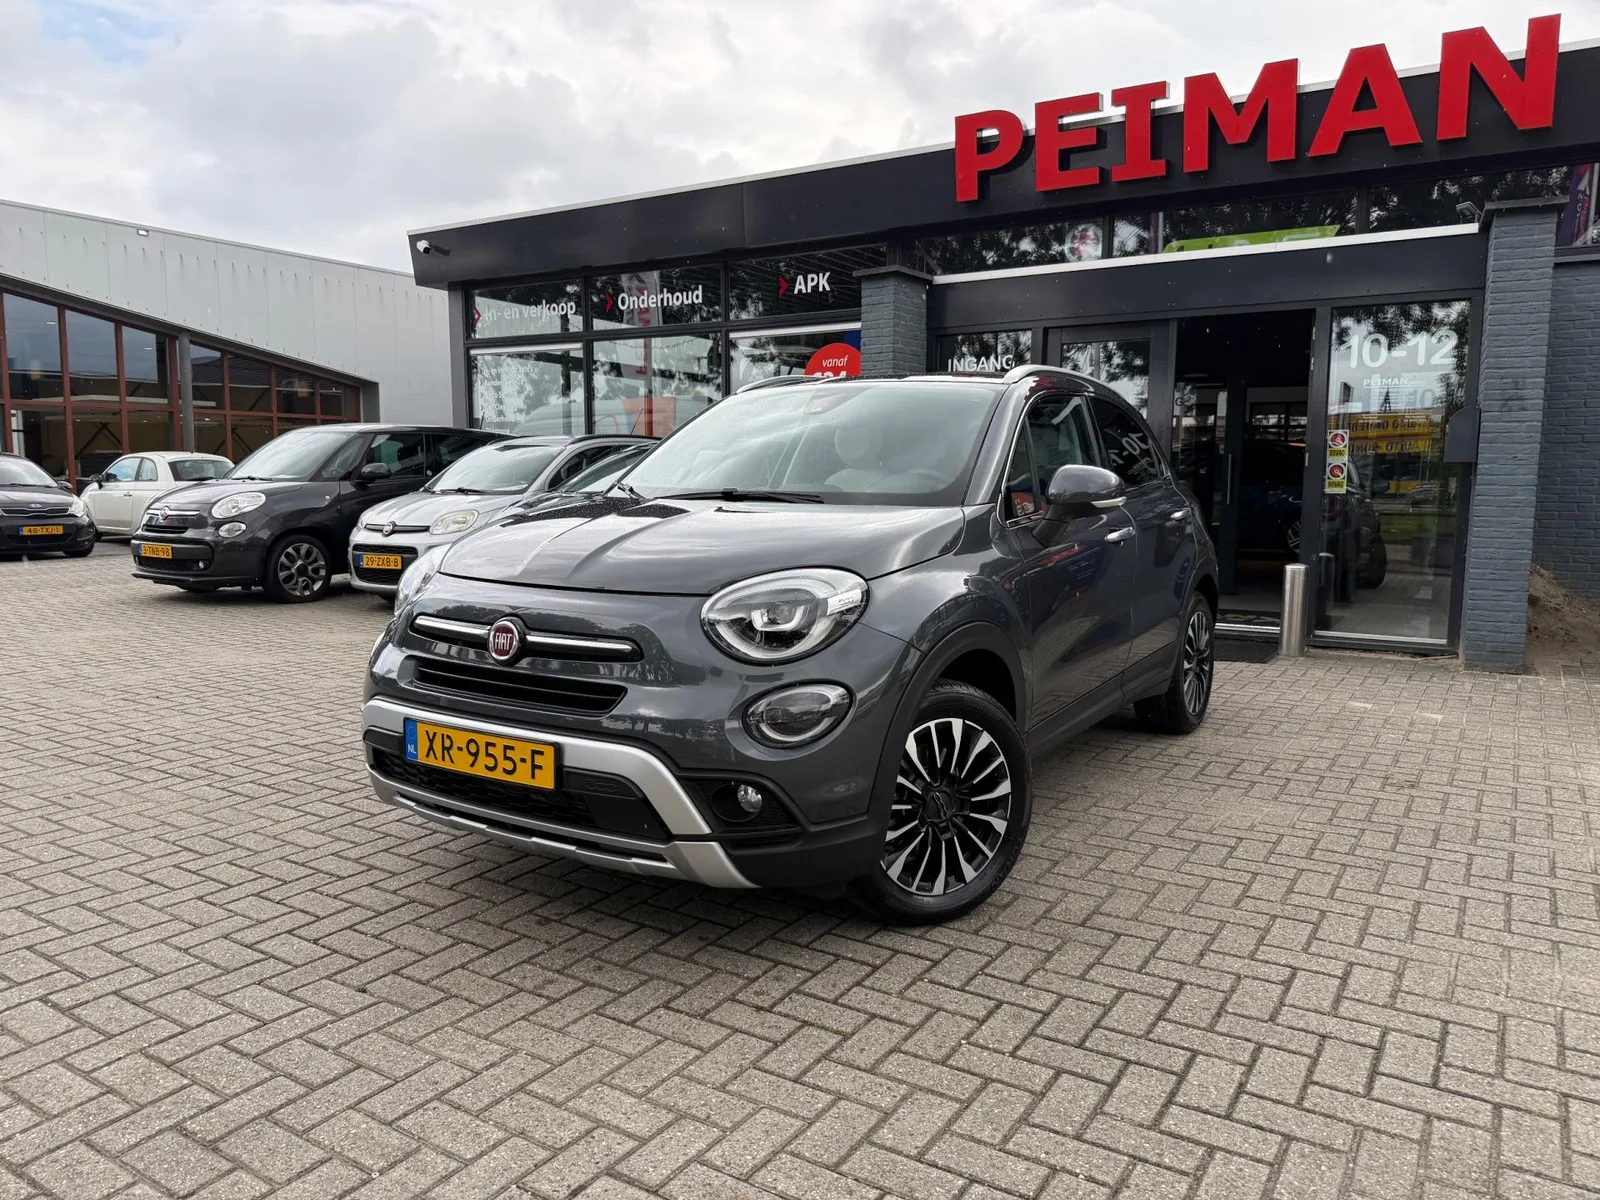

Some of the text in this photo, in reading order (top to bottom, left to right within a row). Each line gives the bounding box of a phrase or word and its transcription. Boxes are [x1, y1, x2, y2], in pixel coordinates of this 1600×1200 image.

[955, 14, 1561, 202] PEIMAN
[794, 272, 831, 294] APK
[617, 284, 703, 310] Onderhoud
[504, 307, 519, 319] en
[522, 299, 576, 320] verkoop
[1340, 329, 1458, 368] 10-12
[822, 355, 848, 367] vanaf
[948, 354, 1015, 372] INGANG
[142, 545, 170, 557] 3-TNB-98
[365, 555, 399, 568] 29-ZXB-8
[494, 632, 513, 650] FIAT
[407, 743, 417, 754] NL
[425, 729, 545, 780] XR-955-F
